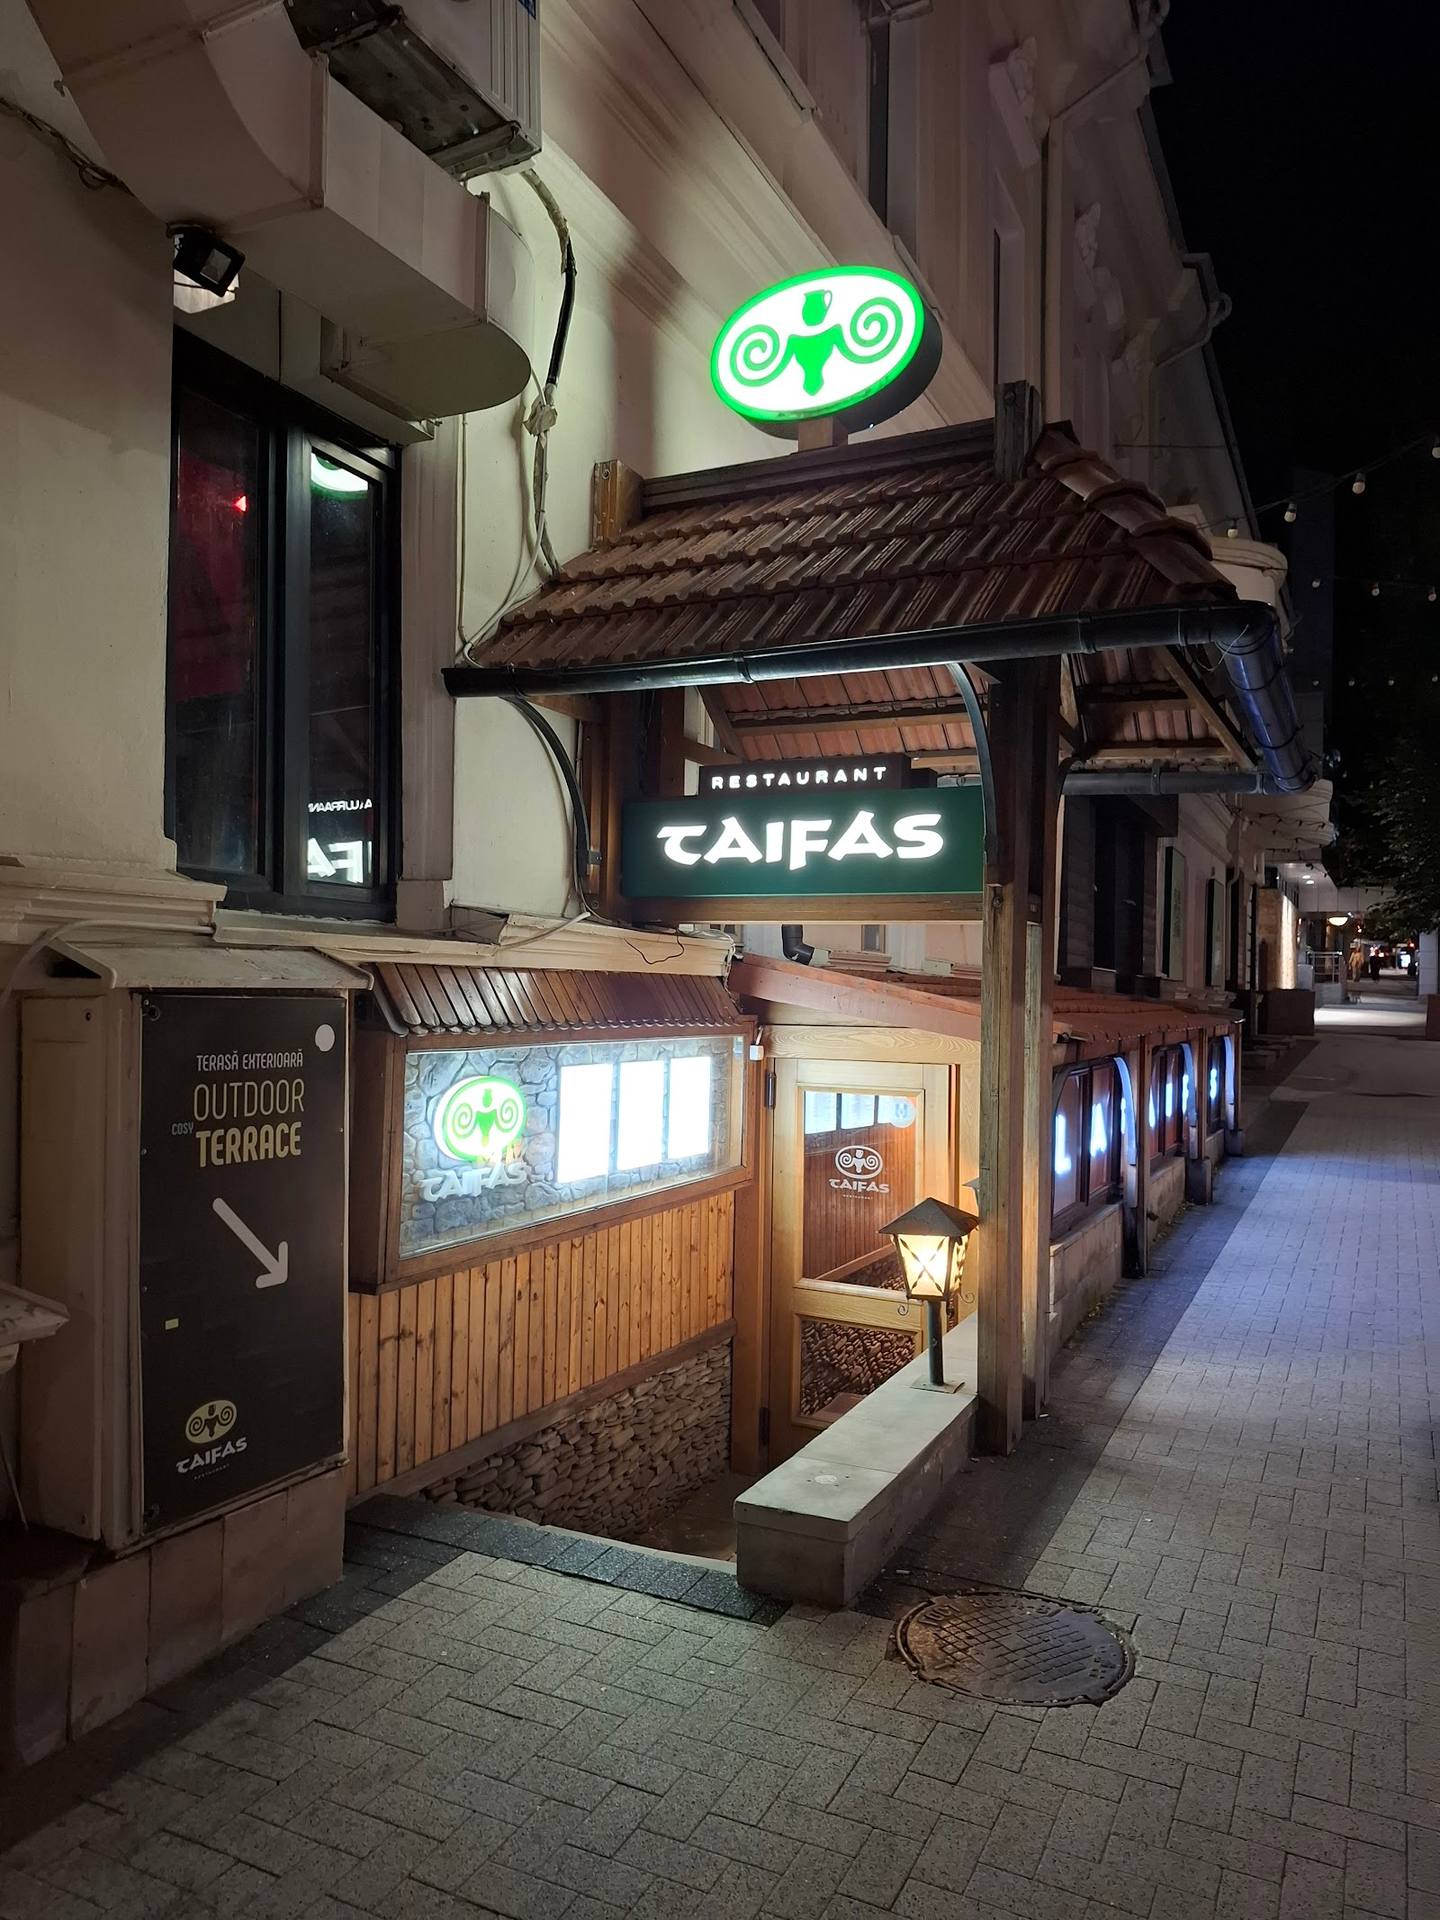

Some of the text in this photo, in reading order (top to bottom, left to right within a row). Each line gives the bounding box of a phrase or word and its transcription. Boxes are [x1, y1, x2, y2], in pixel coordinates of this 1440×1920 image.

[711, 766, 887, 789] RESTAURANT
[656, 810, 944, 871] TAIFAS
[196, 1048, 304, 1072] TERASĂ EXTERIOARĂ
[193, 1078, 305, 1121] OUTDOOR
[171, 1121, 195, 1136] COSY
[195, 1121, 302, 1168] TERRACE
[419, 1160, 531, 1202] TAIFAS
[828, 1178, 890, 1194] TAIFAS
[175, 1436, 248, 1473] TAIFAS
